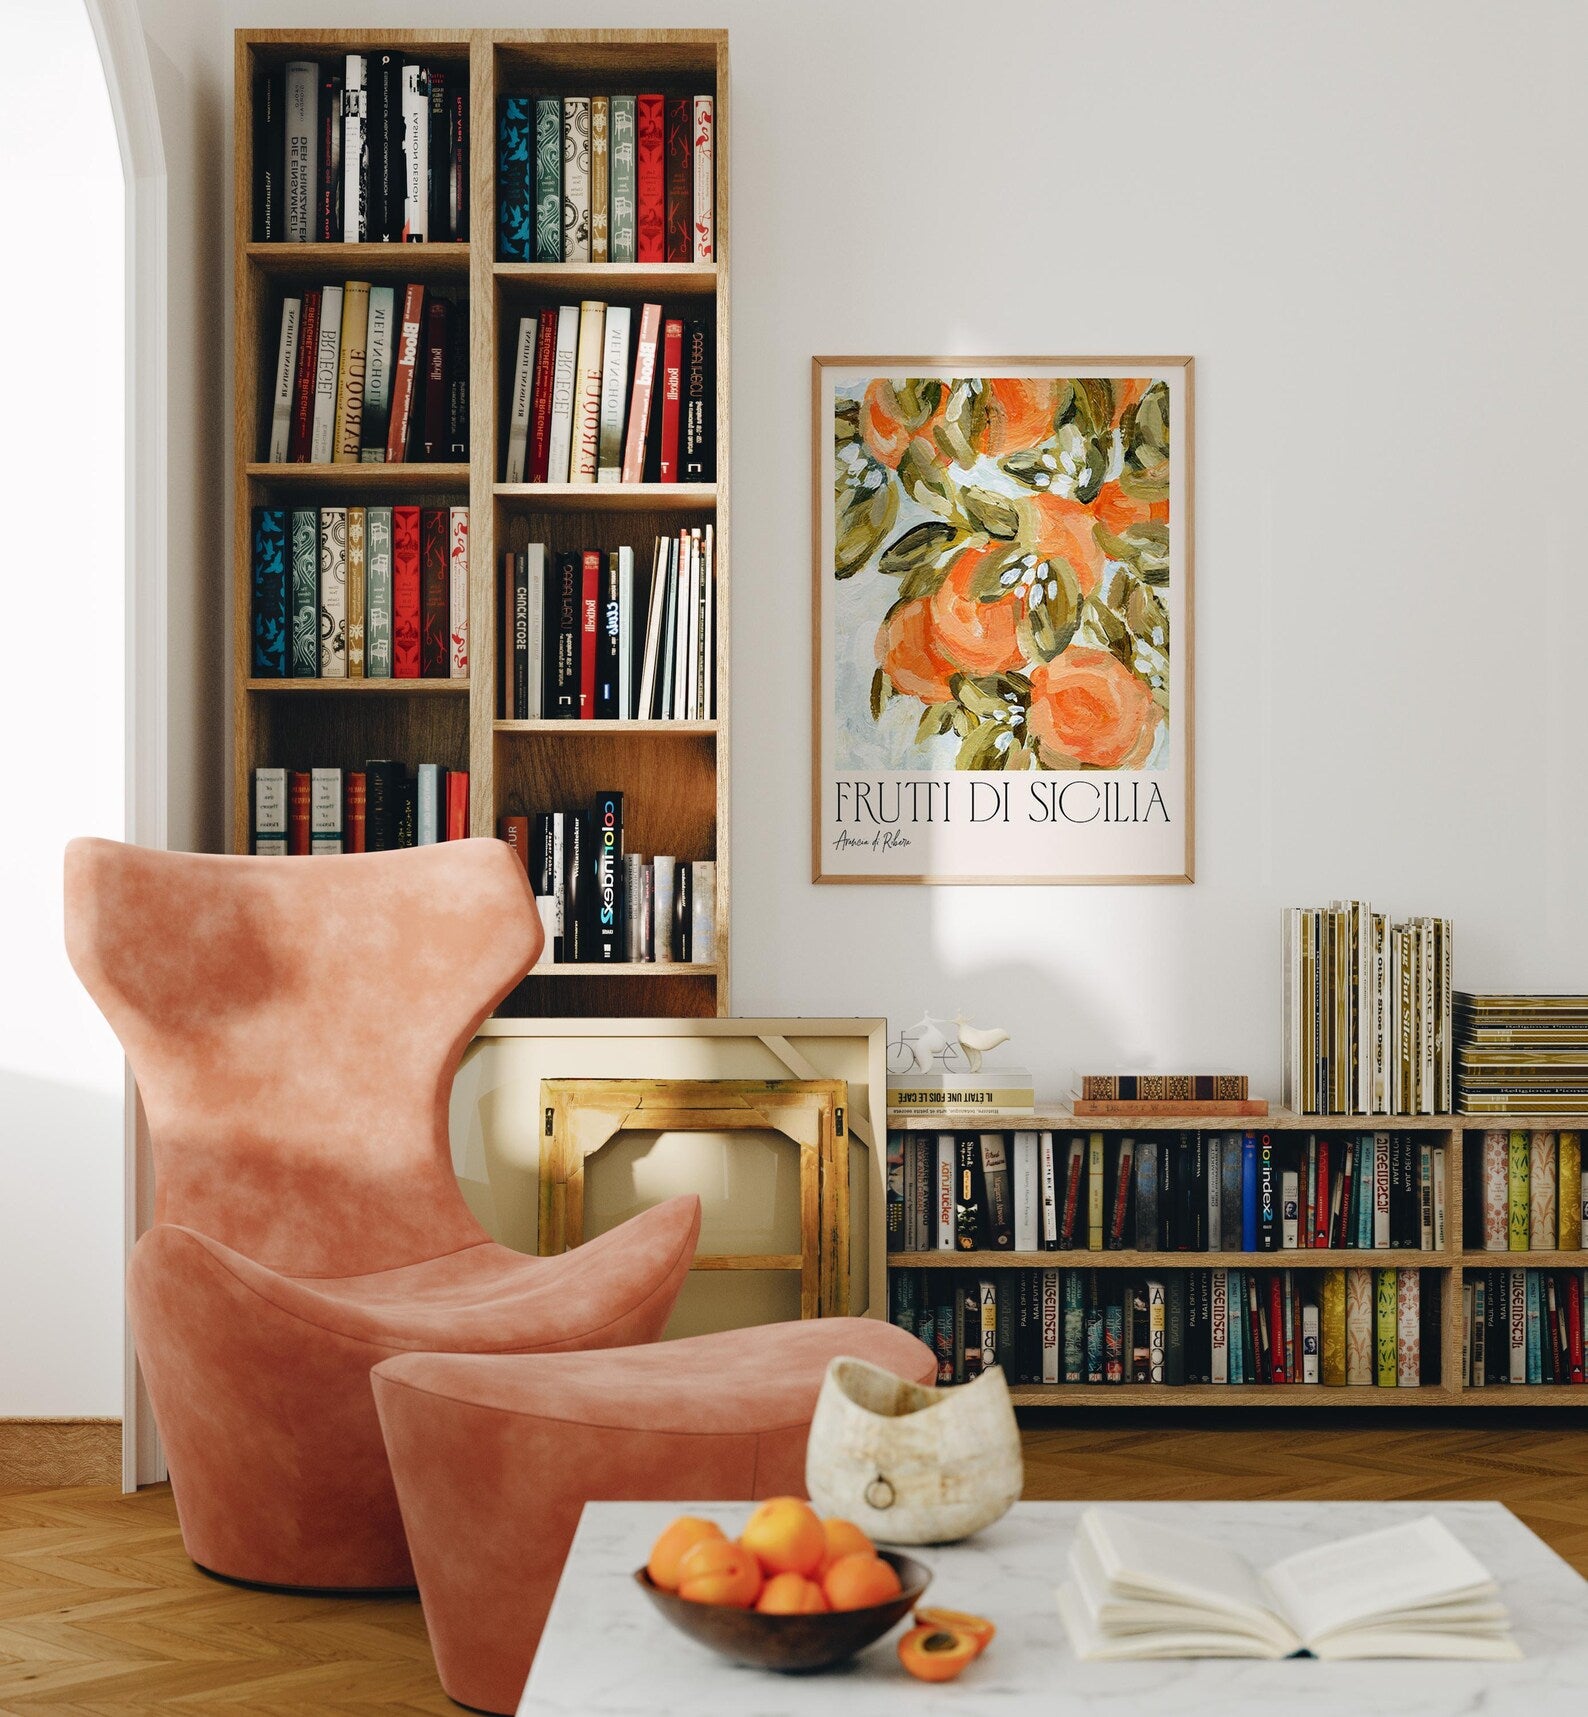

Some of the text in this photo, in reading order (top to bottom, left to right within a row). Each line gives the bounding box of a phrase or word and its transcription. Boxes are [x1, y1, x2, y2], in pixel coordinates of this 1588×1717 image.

[835, 781, 1172, 824] FRUTTI DI SICILIA
[832, 829, 912, 853] Arancia di Ribera
[898, 1092, 993, 1105] IL ÉTAIT UNE FOIS LE CAFÉ
[922, 1189, 930, 1226] ATWOOD
[1043, 1273, 1057, 1349] JUGENDSTIL
[1213, 1273, 1226, 1349] JUGENDSTIL
[1512, 1273, 1525, 1349] JUGENDSTIL
